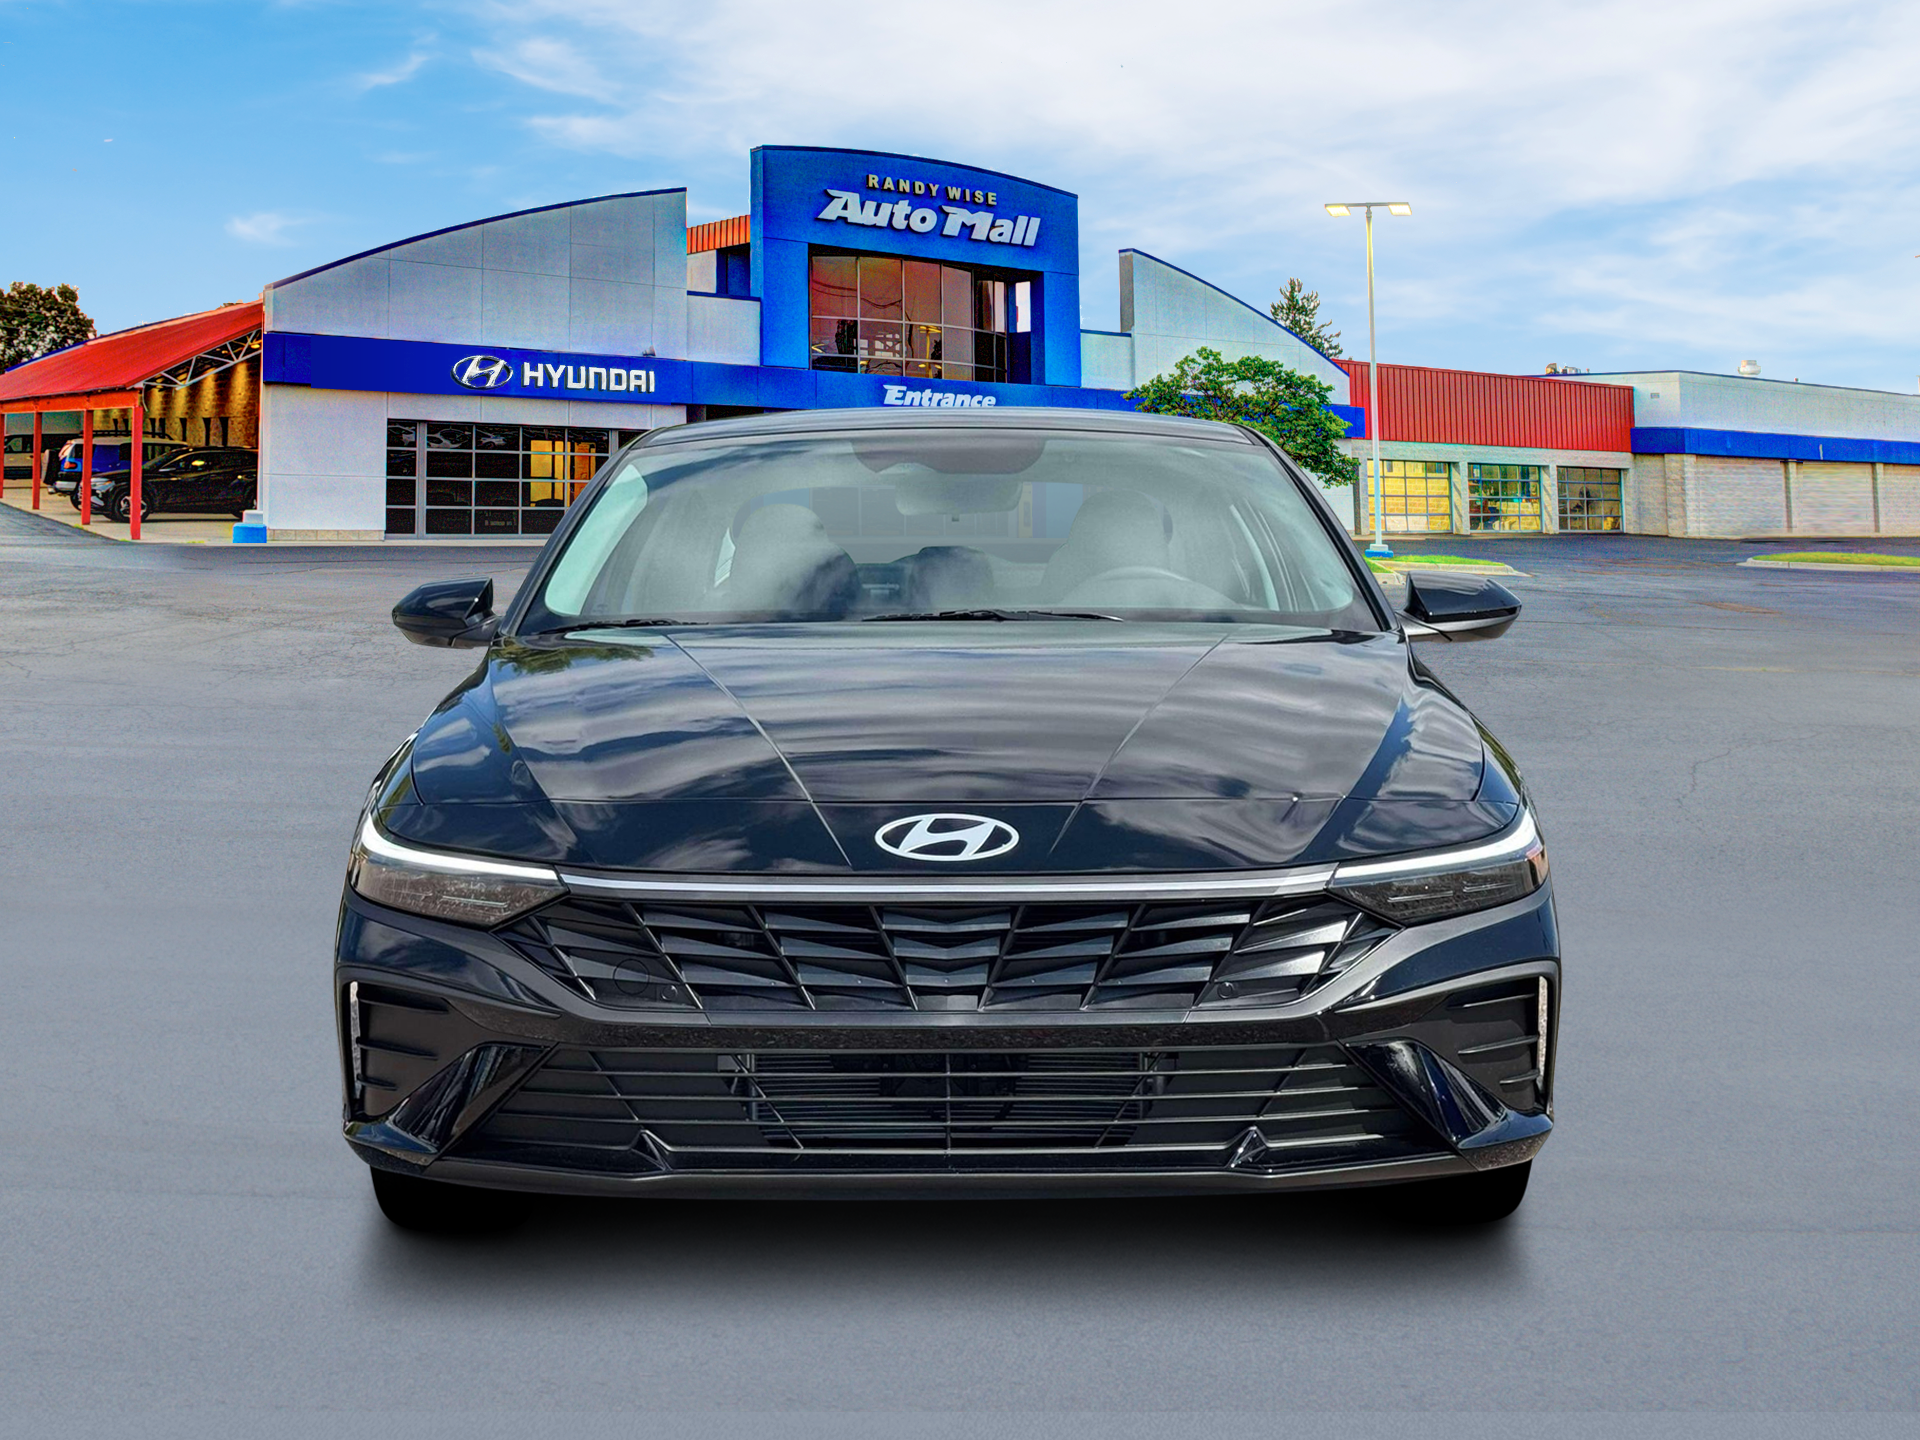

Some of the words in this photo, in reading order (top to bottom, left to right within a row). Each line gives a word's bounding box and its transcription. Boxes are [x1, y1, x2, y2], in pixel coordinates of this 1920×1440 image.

[867, 174, 940, 197] RANDY
[946, 185, 998, 205] WISE
[818, 189, 938, 233] Auto
[941, 205, 1041, 247] Mall
[523, 362, 655, 393] HYUNDAI
[883, 384, 997, 407] Entrance
